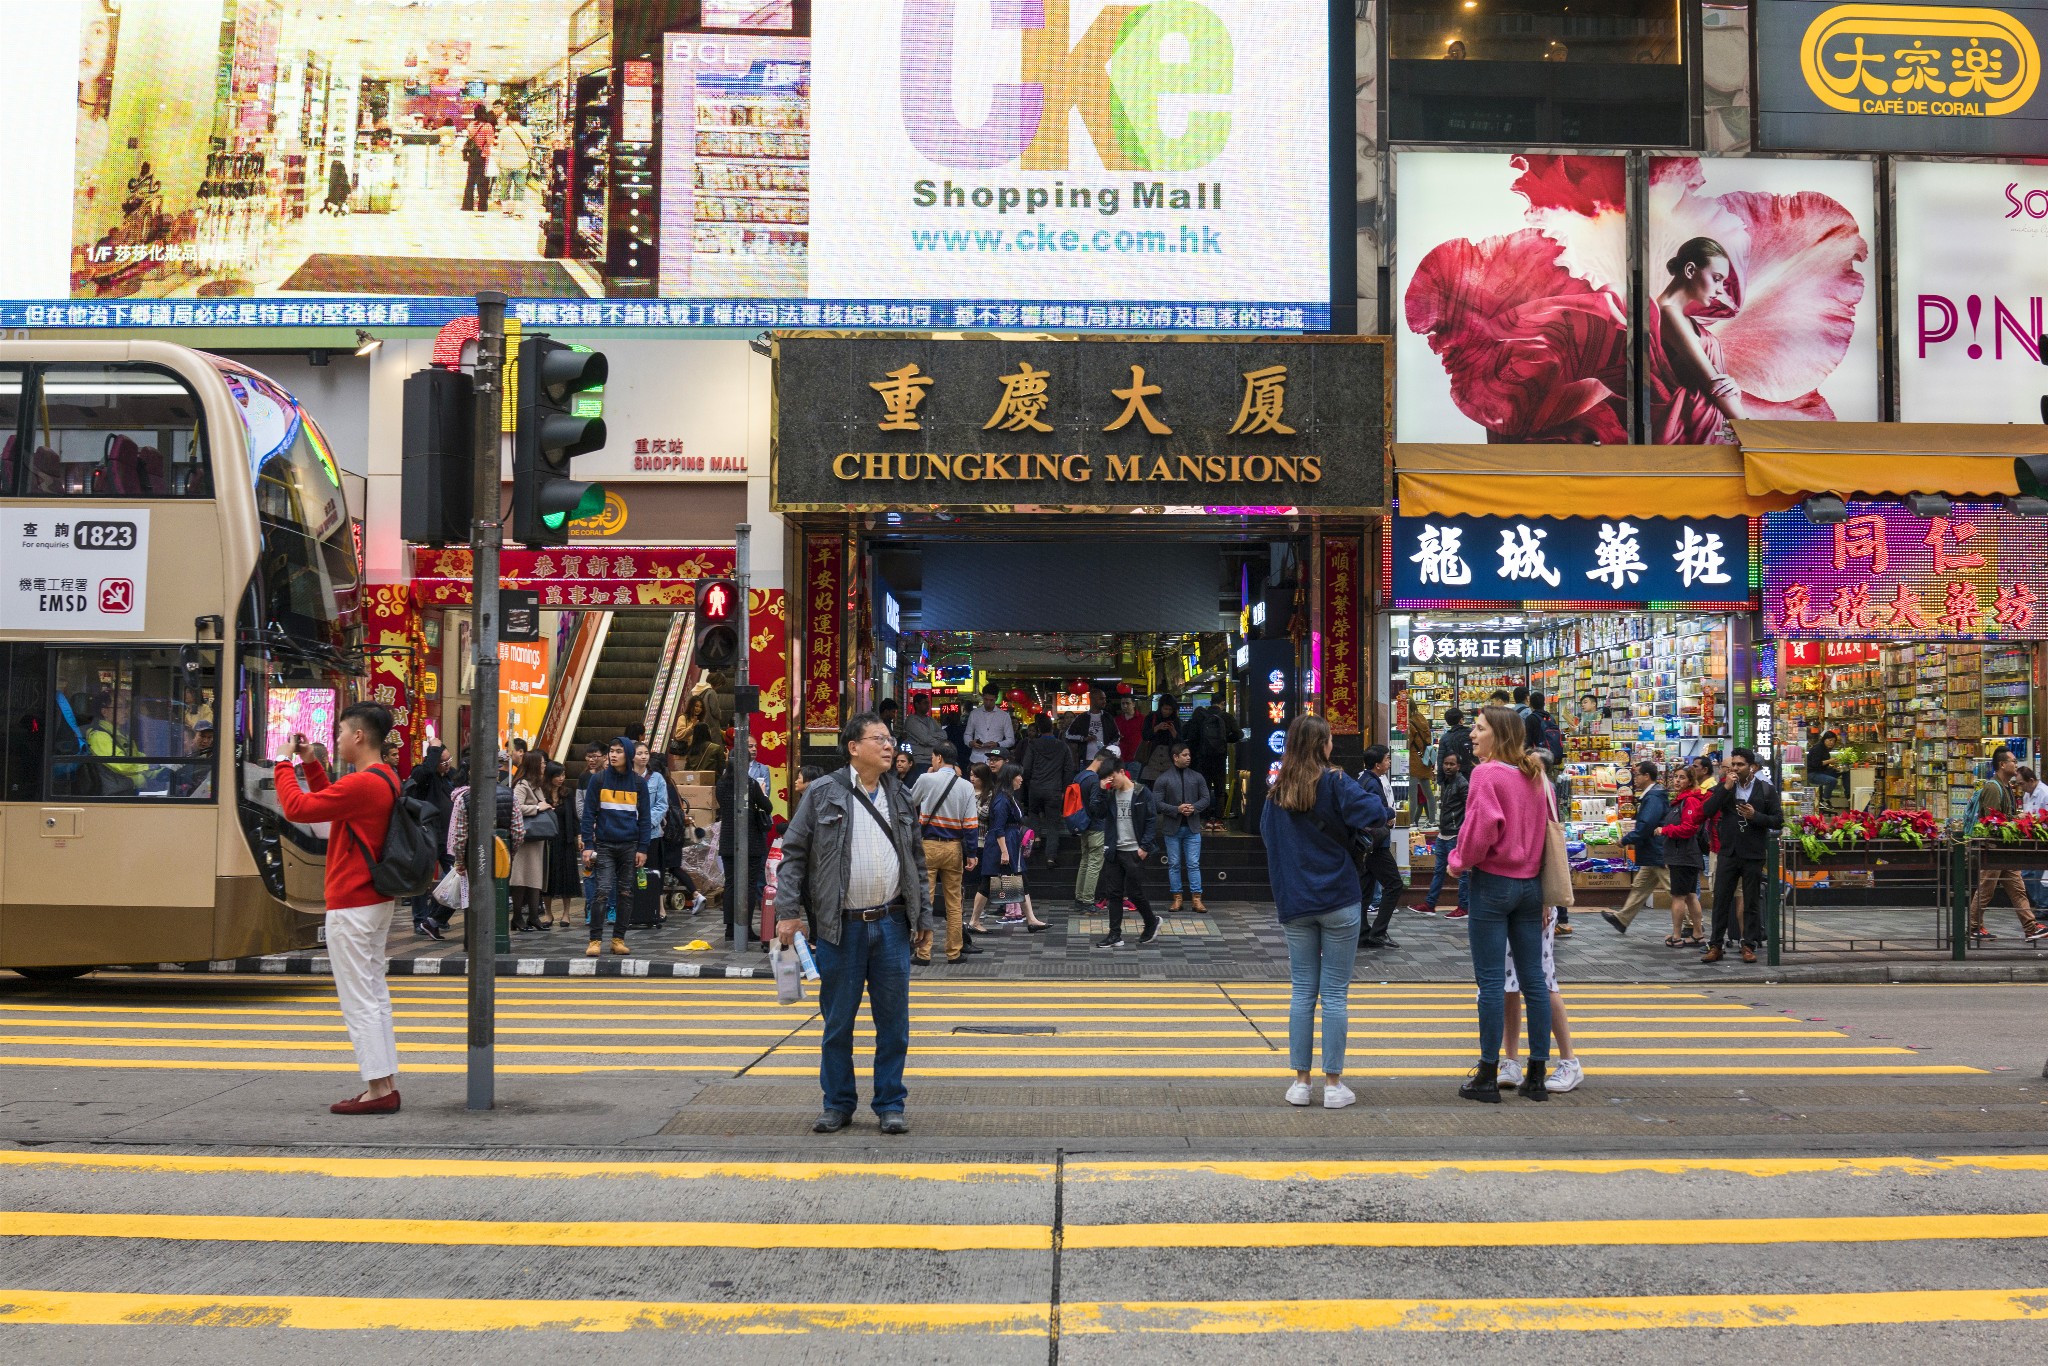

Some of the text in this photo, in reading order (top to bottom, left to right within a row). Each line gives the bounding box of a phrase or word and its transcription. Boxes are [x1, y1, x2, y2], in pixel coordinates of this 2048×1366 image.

[672, 39, 745, 64] BCL
[1862, 97, 1985, 116] CAFÉ DE CORAL
[912, 179, 1222, 216] Shopping Mall
[911, 224, 1223, 253] www.cke.com.hk
[86, 246, 112, 263] 1/F
[633, 438, 684, 455] 重庆站
[633, 455, 749, 472] SHOPPING MALL
[832, 452, 1323, 484] CHUNGKING MANSIONS
[22, 522, 70, 539] 查詢
[76, 525, 133, 547] 1823
[22, 541, 70, 550] For enquiries
[1832, 514, 1988, 576] 同仁
[531, 554, 639, 579] 恭賀新禧
[18, 577, 89, 592] 機電工程署
[39, 594, 88, 613] EMSD
[545, 585, 633, 605] 萬事如意
[510, 644, 541, 671] mannings
